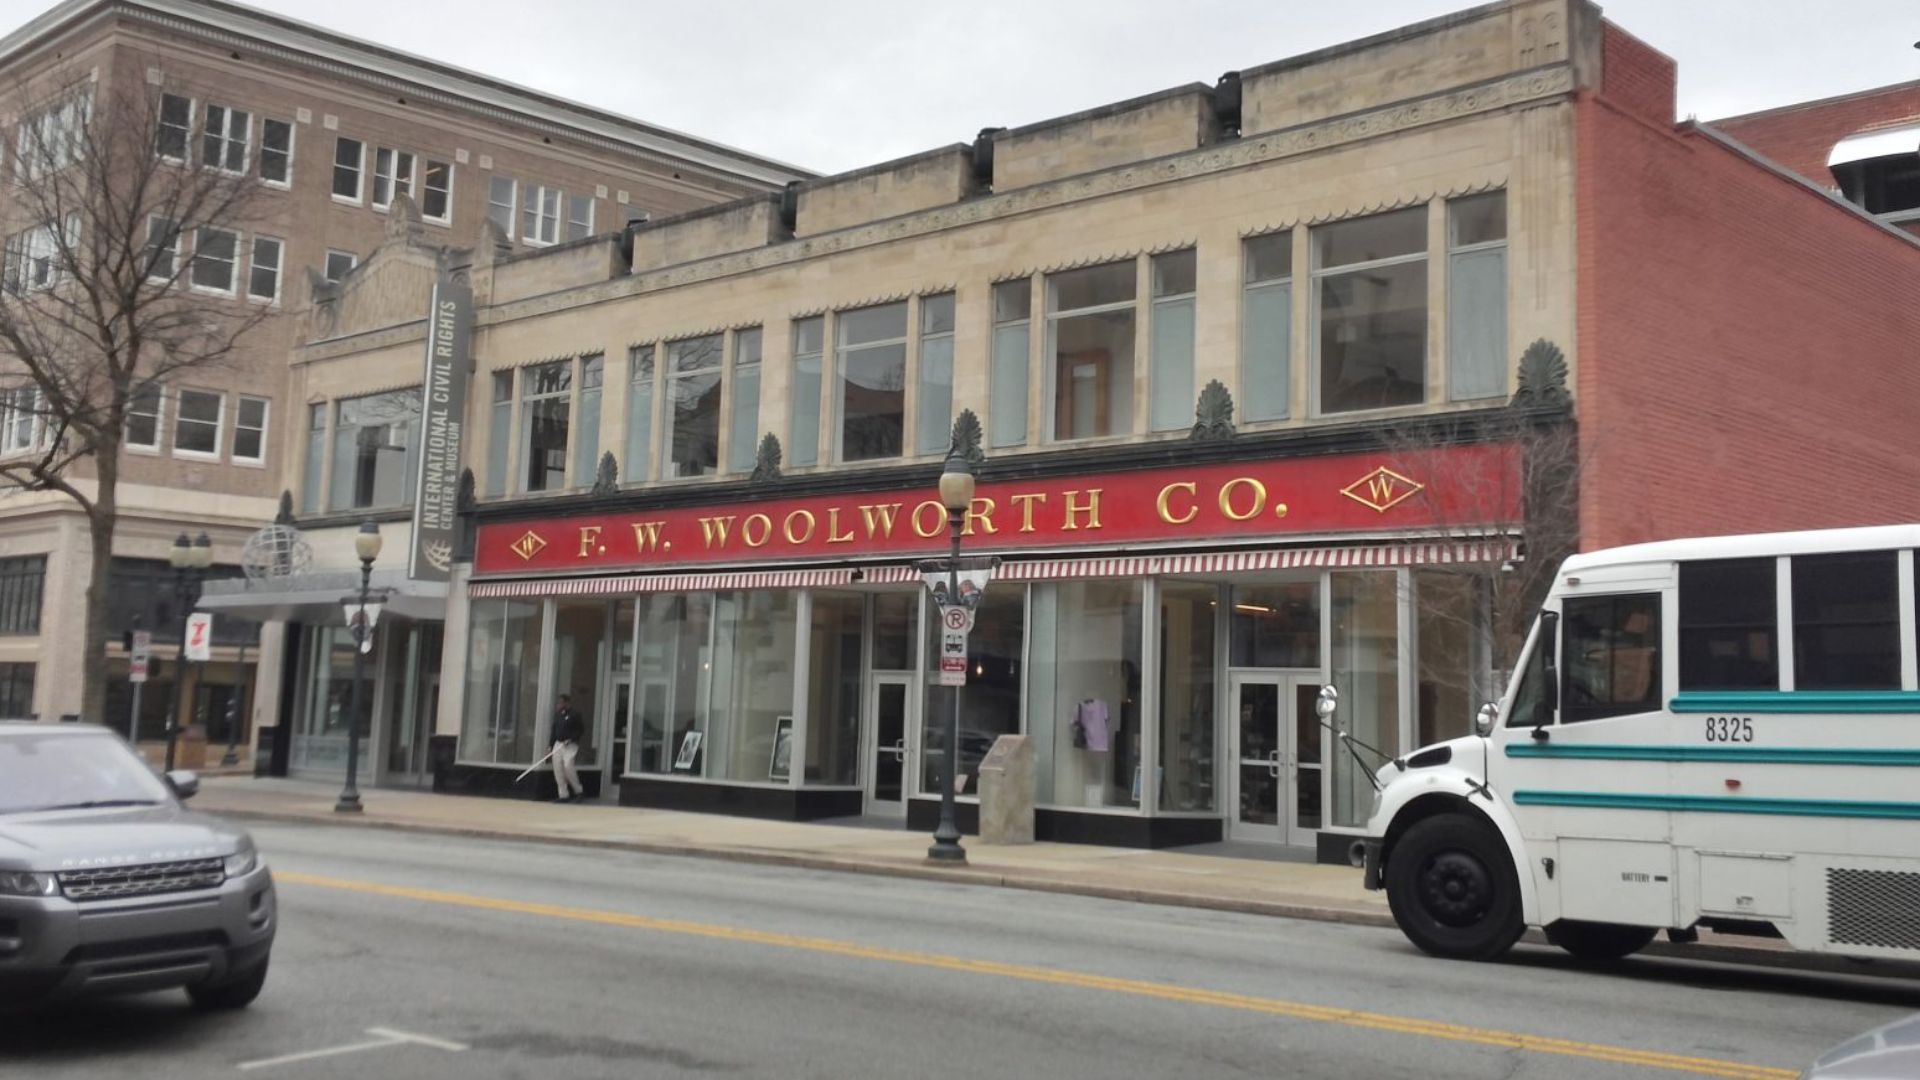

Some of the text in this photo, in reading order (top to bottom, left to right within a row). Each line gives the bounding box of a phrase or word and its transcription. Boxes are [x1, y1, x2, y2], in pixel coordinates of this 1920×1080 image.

[422, 300, 456, 529] INTERNATIONAL CIVIL RIGHTS
[440, 421, 460, 530] CENTER & MUSEUM
[1369, 473, 1395, 503] W
[577, 477, 1288, 558] F. W. WOOLWORTH CO.
[1705, 717, 1753, 742] 8325
